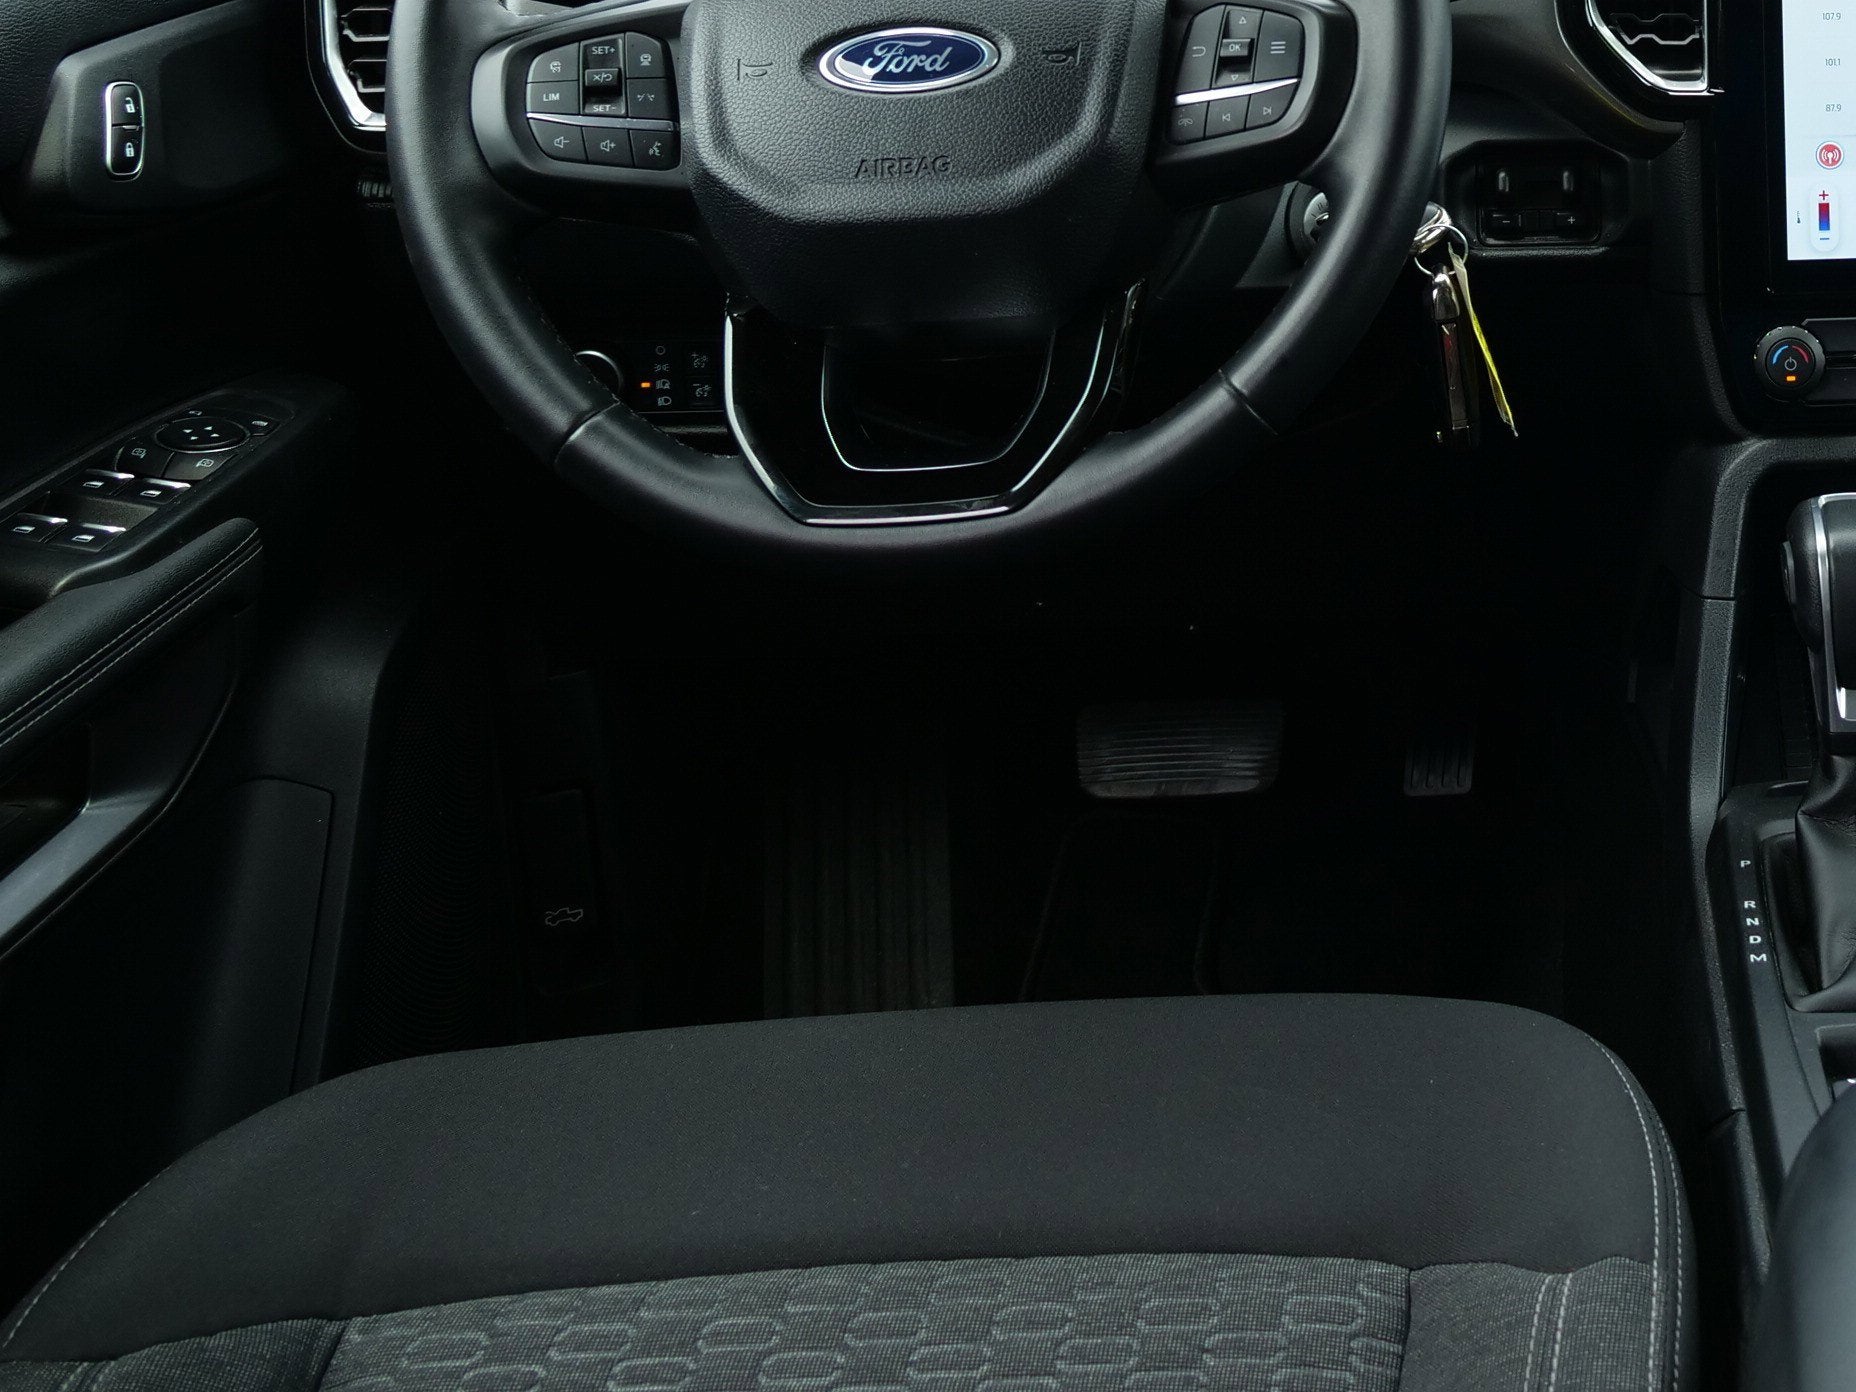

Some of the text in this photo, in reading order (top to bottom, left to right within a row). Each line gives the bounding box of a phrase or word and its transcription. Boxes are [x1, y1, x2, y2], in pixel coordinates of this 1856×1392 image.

[1822, 12, 1842, 21] 107.9
[1228, 43, 1241, 52] OK
[862, 40, 953, 75] Ford
[543, 93, 560, 102] LIM
[1825, 103, 1842, 112] 87.9
[854, 155, 951, 179] AIRBAG
[1740, 860, 1751, 868] P
[1744, 900, 1756, 908] R
[1746, 917, 1759, 926] N
[1749, 935, 1761, 944] D
[1750, 953, 1767, 962] M
